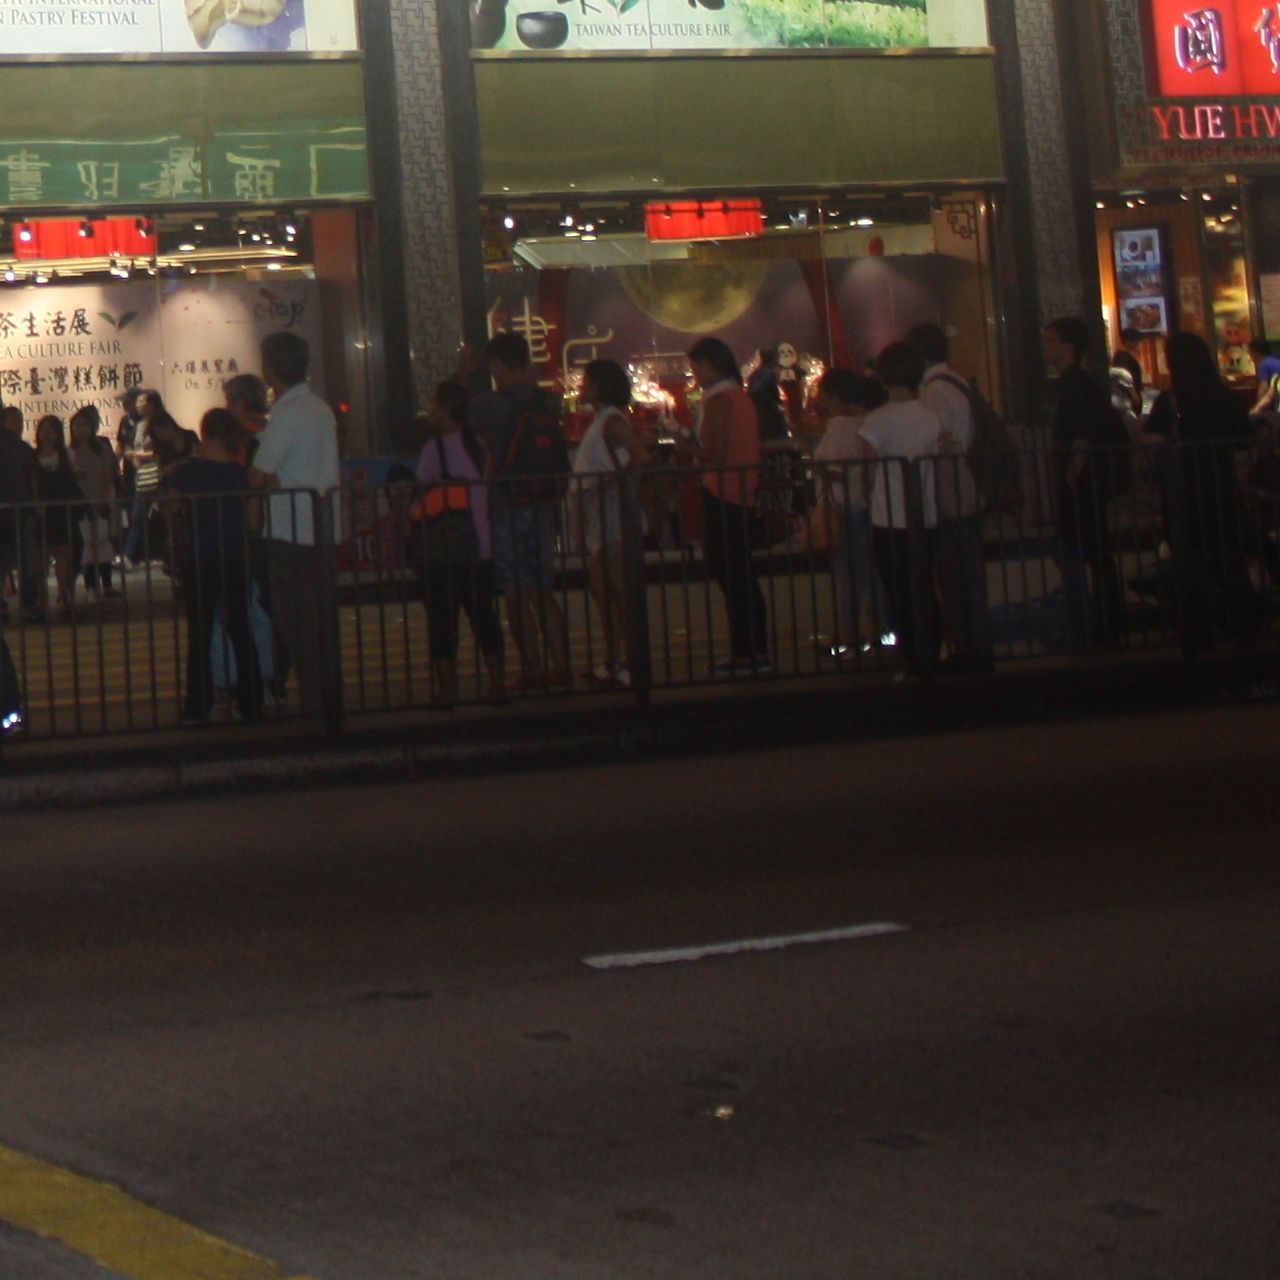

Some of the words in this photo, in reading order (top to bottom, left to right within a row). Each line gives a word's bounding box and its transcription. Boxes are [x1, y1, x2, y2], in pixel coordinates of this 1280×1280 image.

[574, 23, 623, 38] TAIWAN
[625, 23, 648, 37] TEA
[650, 23, 705, 37] CULTURE
[706, 23, 732, 37] FAIR
[1152, 104, 1226, 141] YUE
[1233, 104, 1280, 140] HW
[17, 342, 86, 360] CULTURE
[89, 340, 124, 355] FAIR
